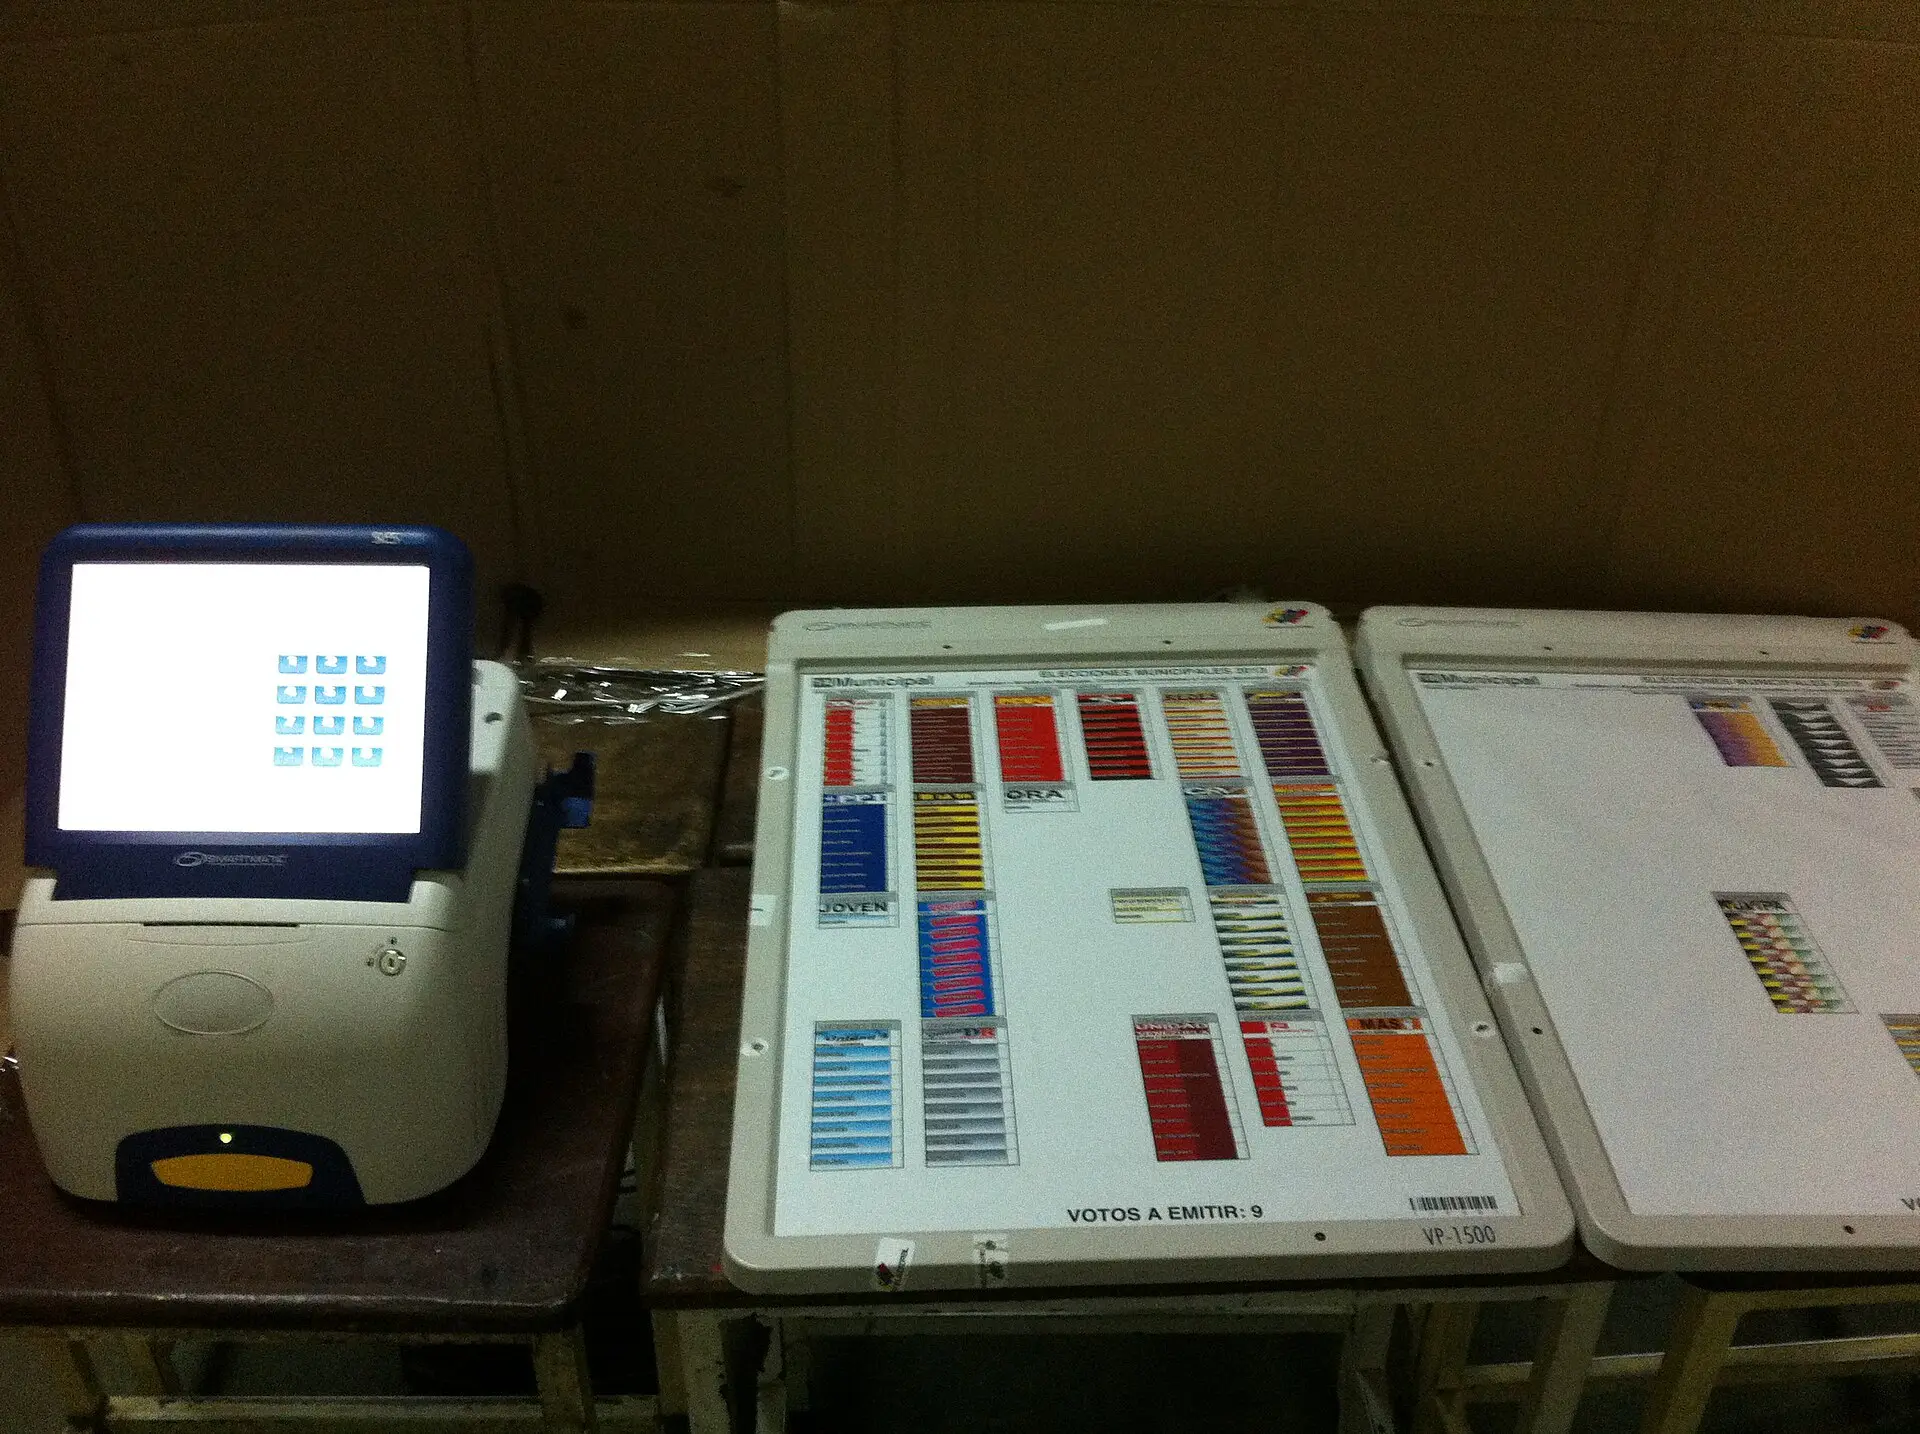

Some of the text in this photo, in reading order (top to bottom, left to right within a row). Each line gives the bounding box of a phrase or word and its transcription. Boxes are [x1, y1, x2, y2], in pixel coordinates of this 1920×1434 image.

[835, 675, 935, 688] Municipal
[1005, 789, 1065, 800] ORA
[818, 901, 889, 913] JOVEN
[1066, 1204, 1264, 1223] VOTOS A EMITIR: 9
[1421, 1224, 1497, 1246] VP-1500
